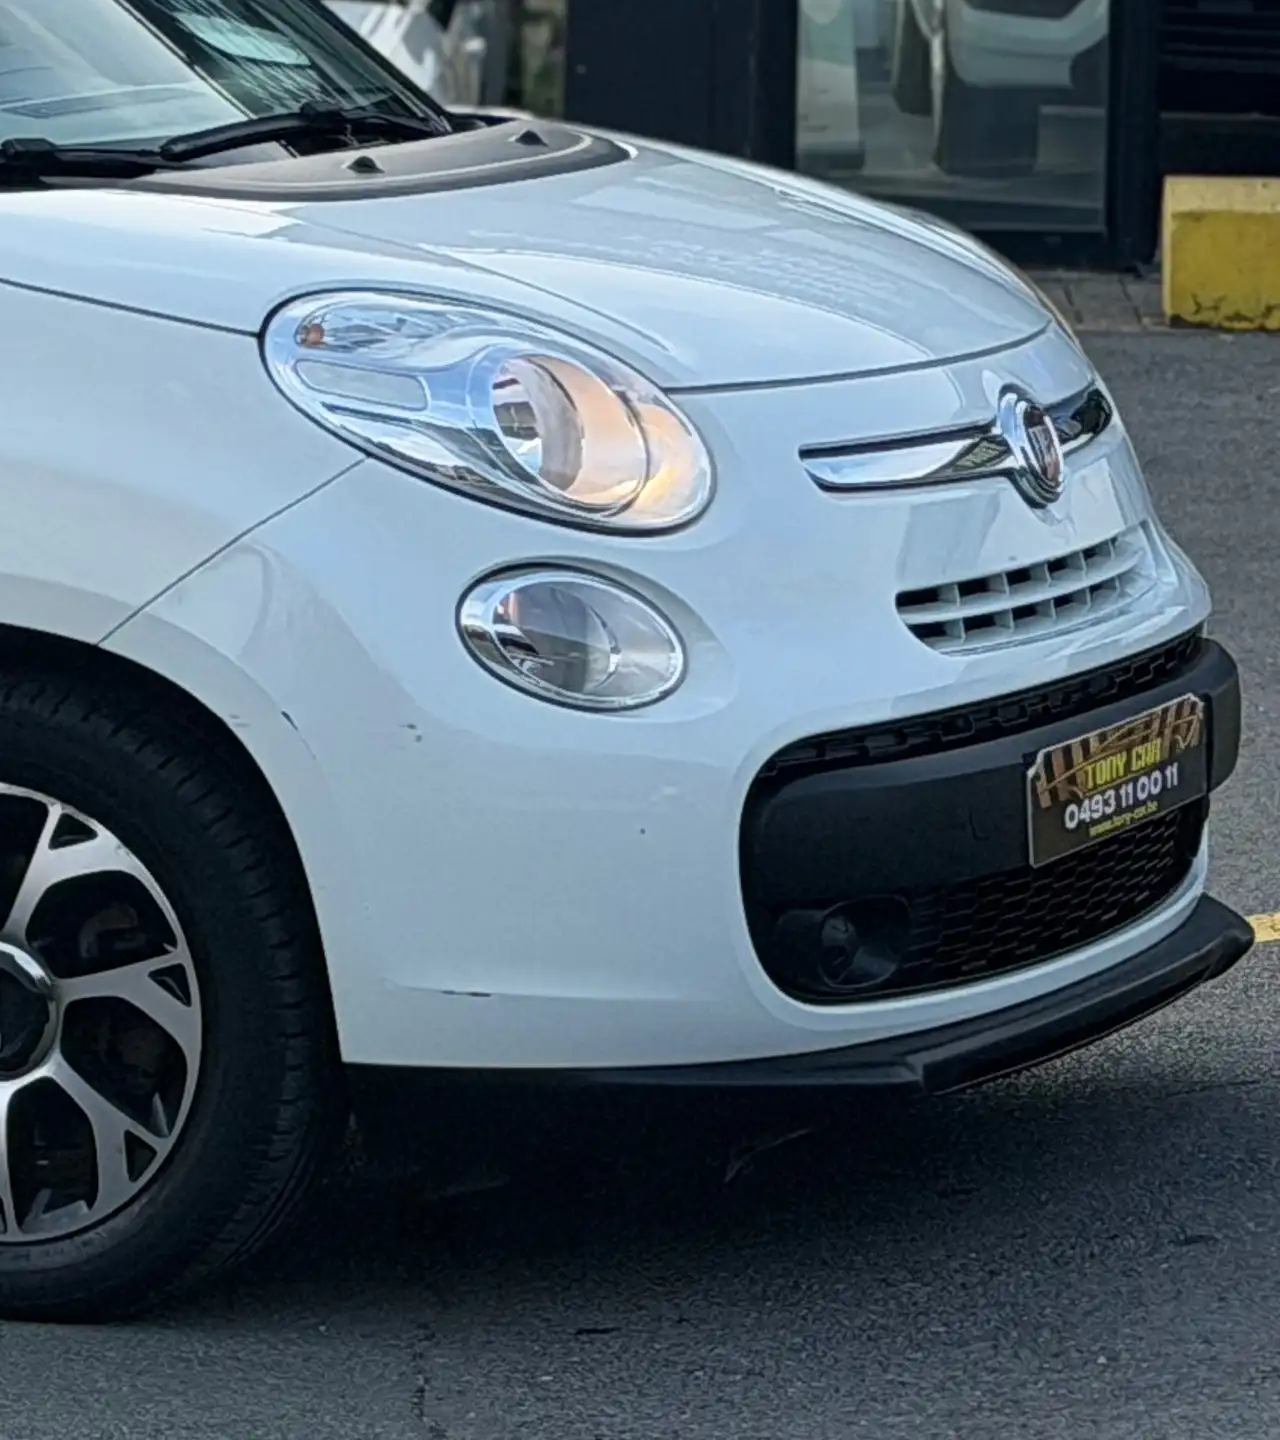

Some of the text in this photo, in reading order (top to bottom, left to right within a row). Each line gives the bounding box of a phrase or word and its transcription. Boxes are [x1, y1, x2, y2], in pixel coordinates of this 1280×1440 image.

[1084, 738, 1162, 789] TONY CAR
[1064, 762, 1178, 830] 0493 11 00 11
